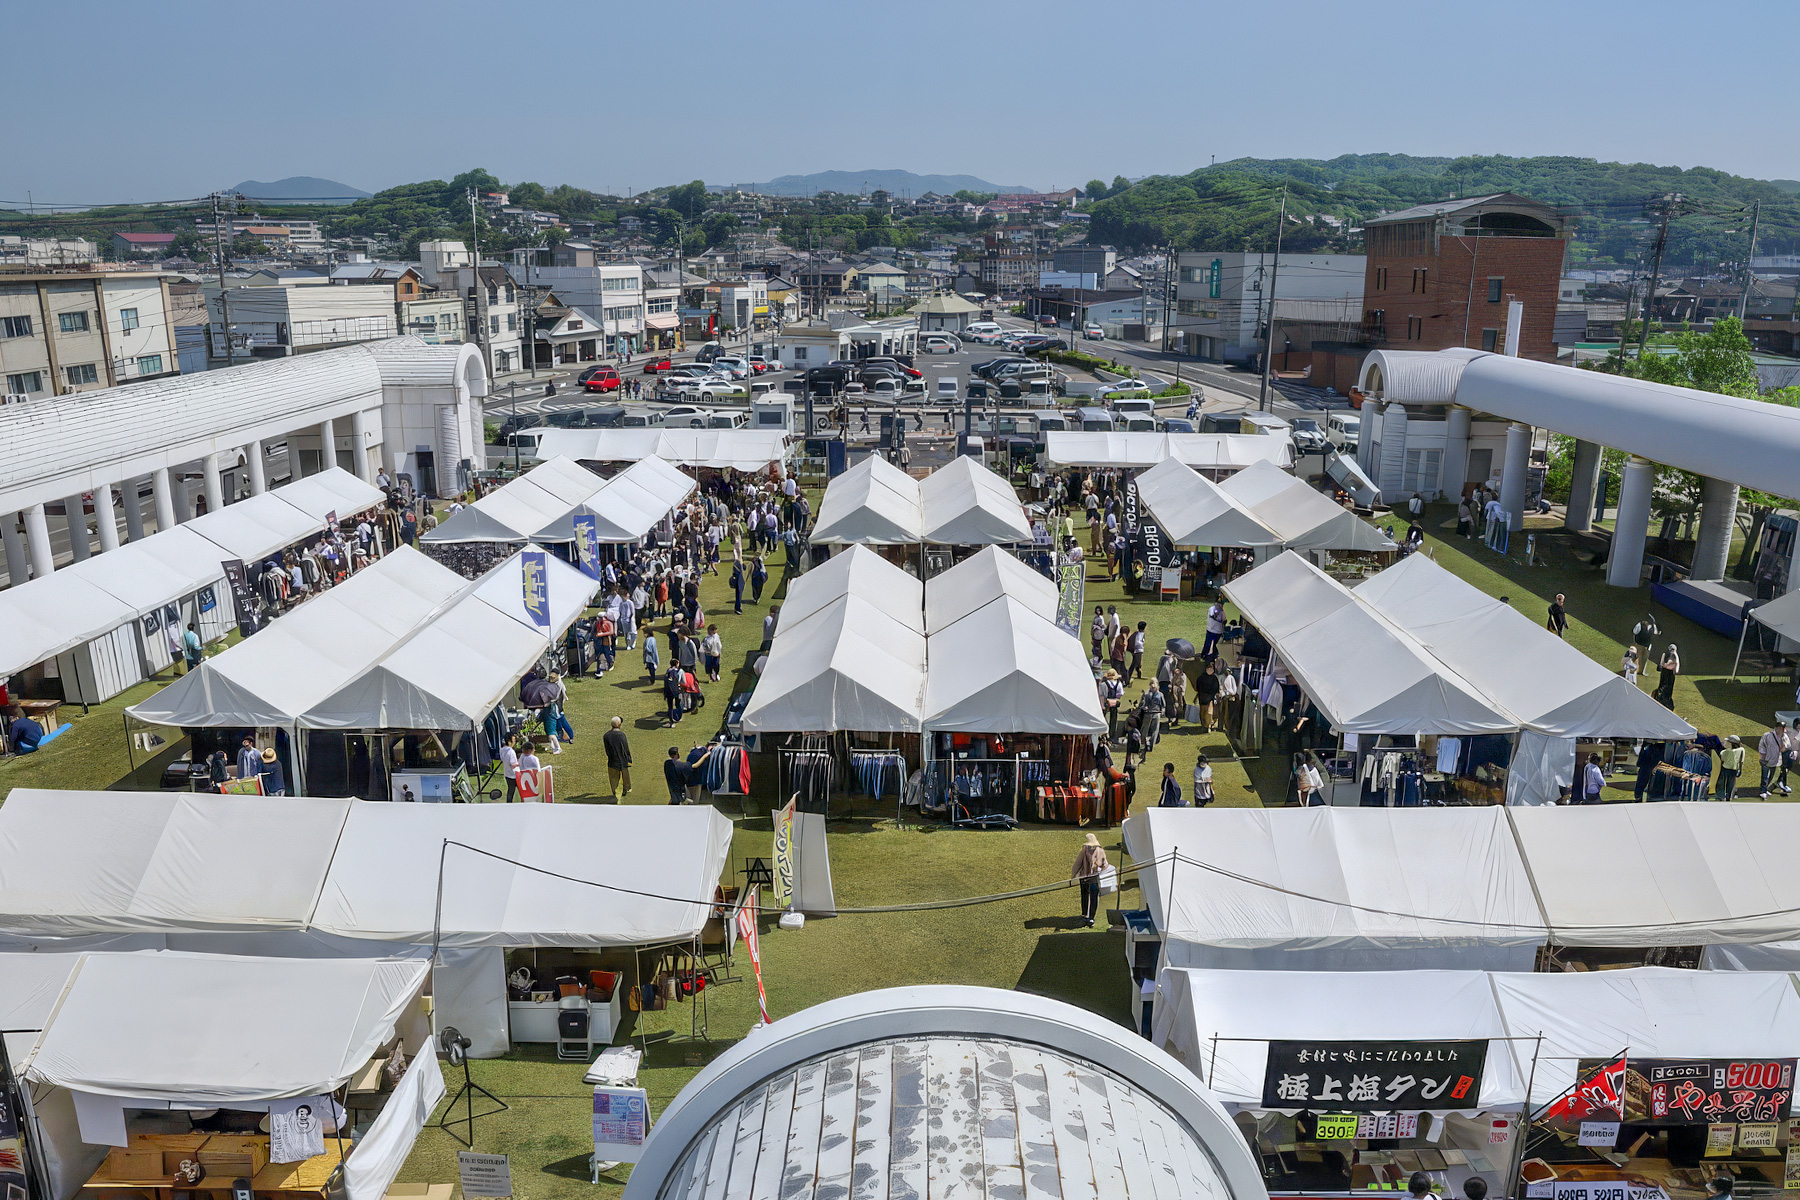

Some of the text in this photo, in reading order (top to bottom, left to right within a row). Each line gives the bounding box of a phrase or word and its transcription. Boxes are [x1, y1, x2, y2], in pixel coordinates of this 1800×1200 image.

[1276, 1073, 1452, 1102] 極上塩タン
[1727, 1062, 1781, 1090] 500
